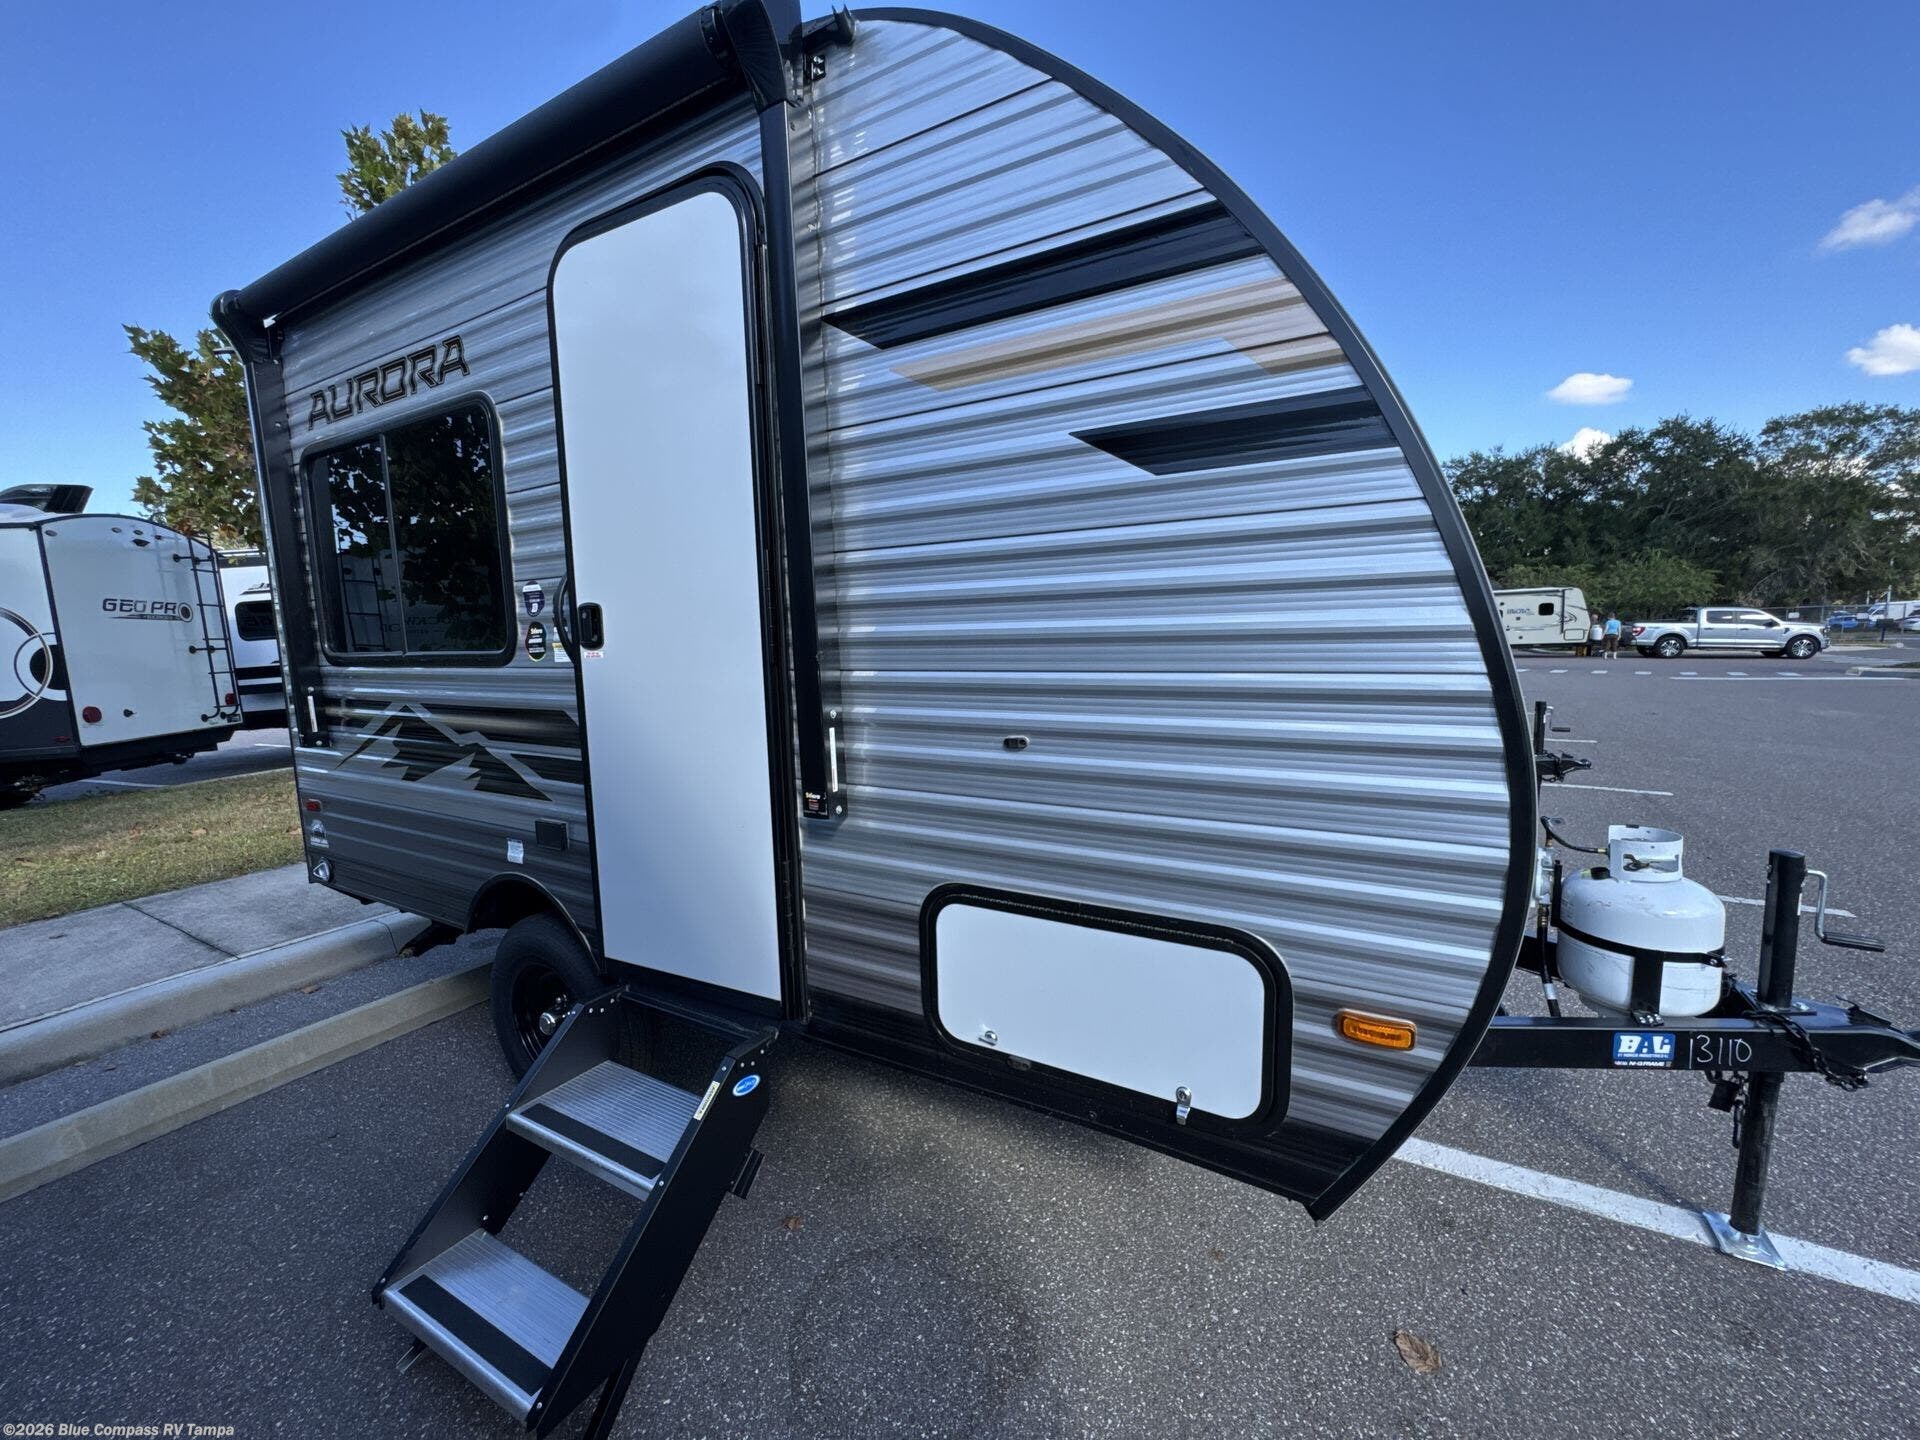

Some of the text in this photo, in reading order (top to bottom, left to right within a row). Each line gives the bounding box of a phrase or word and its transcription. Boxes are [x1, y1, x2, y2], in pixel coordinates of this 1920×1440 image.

[308, 335, 470, 431] AURORA
[102, 598, 147, 613] GEO
[1689, 1034, 1752, 1069] 13110
